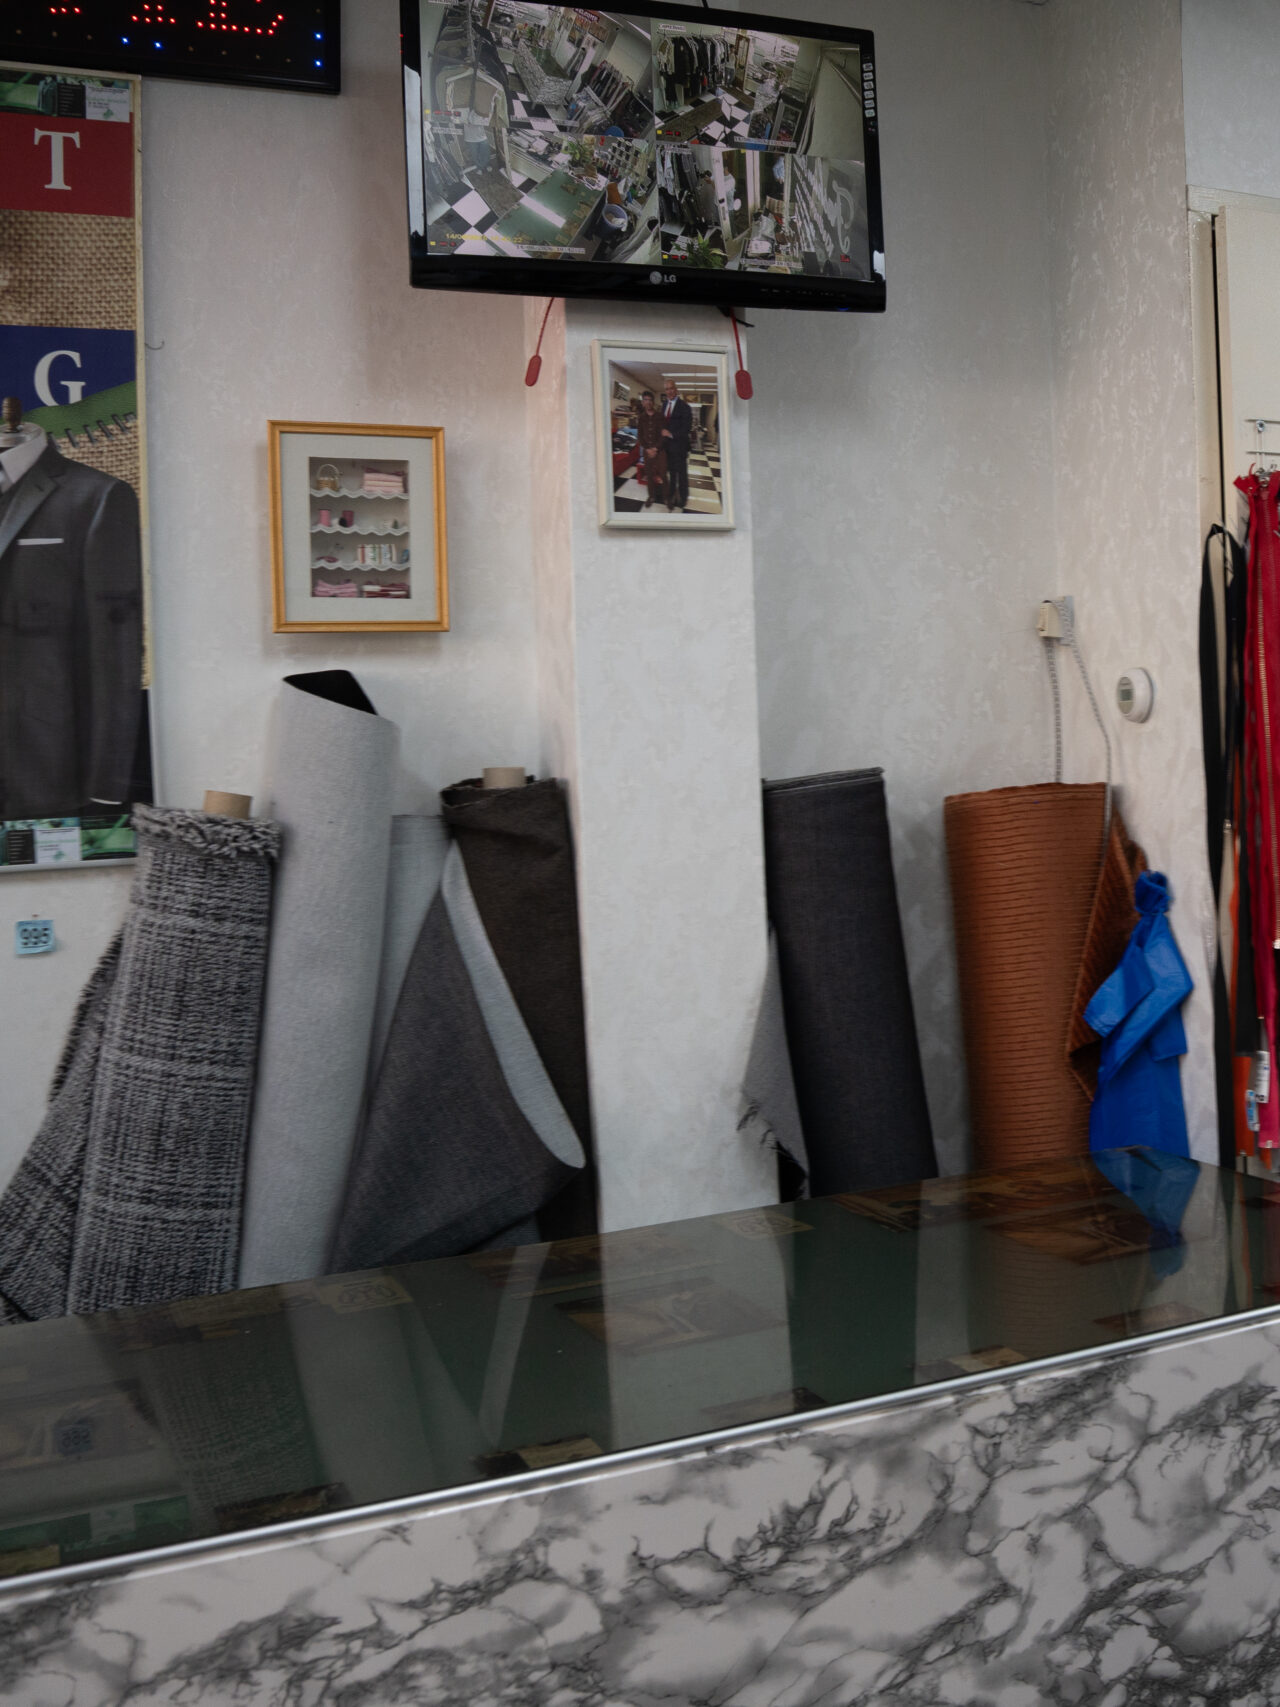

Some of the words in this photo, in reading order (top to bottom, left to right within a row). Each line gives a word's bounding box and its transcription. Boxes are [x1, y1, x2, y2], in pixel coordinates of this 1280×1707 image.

[33, 128, 81, 191] T
[663, 274, 677, 283] LG
[34, 350, 86, 407] G
